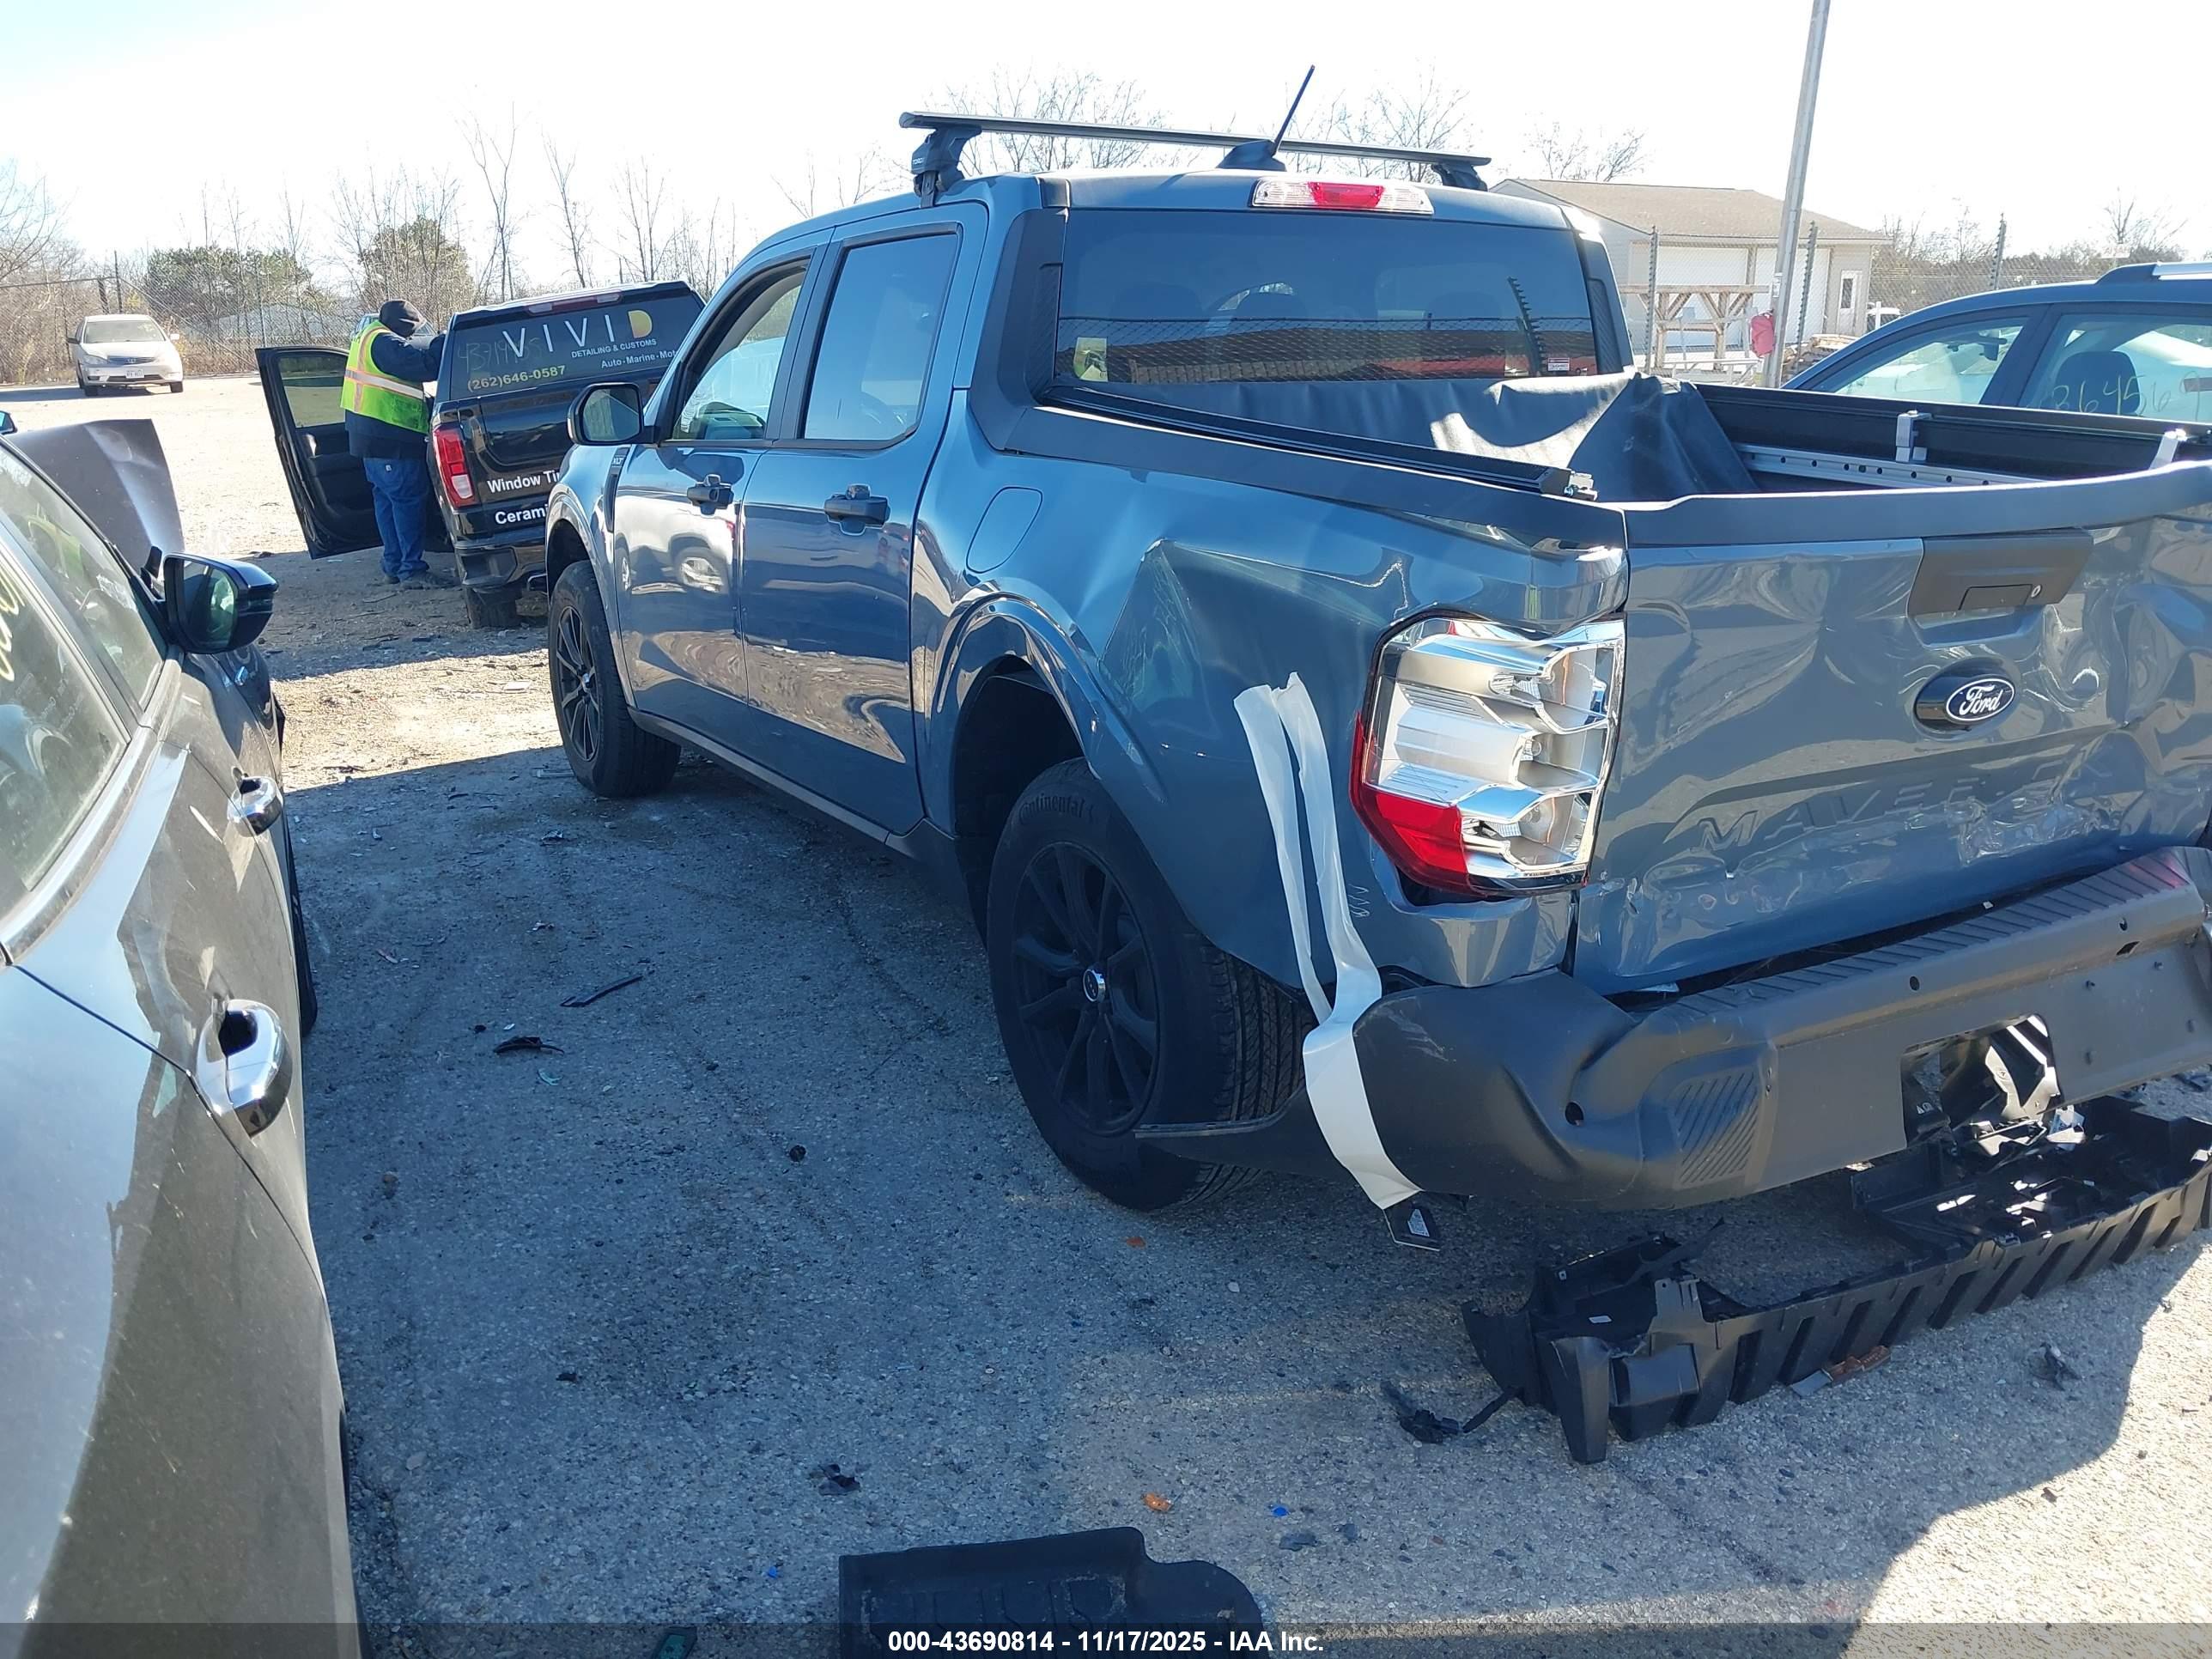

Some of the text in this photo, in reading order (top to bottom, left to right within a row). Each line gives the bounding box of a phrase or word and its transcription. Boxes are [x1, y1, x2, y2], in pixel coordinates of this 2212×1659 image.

[502, 309, 653, 358] VIVID
[571, 345, 611, 358] DETAILING
[620, 338, 657, 350] CUSTOMS
[659, 349, 678, 360] Mot
[467, 365, 566, 392] (262)646-0587
[487, 473, 541, 494] Window
[495, 504, 549, 525] Cerami
[1959, 684, 2003, 716] Ford
